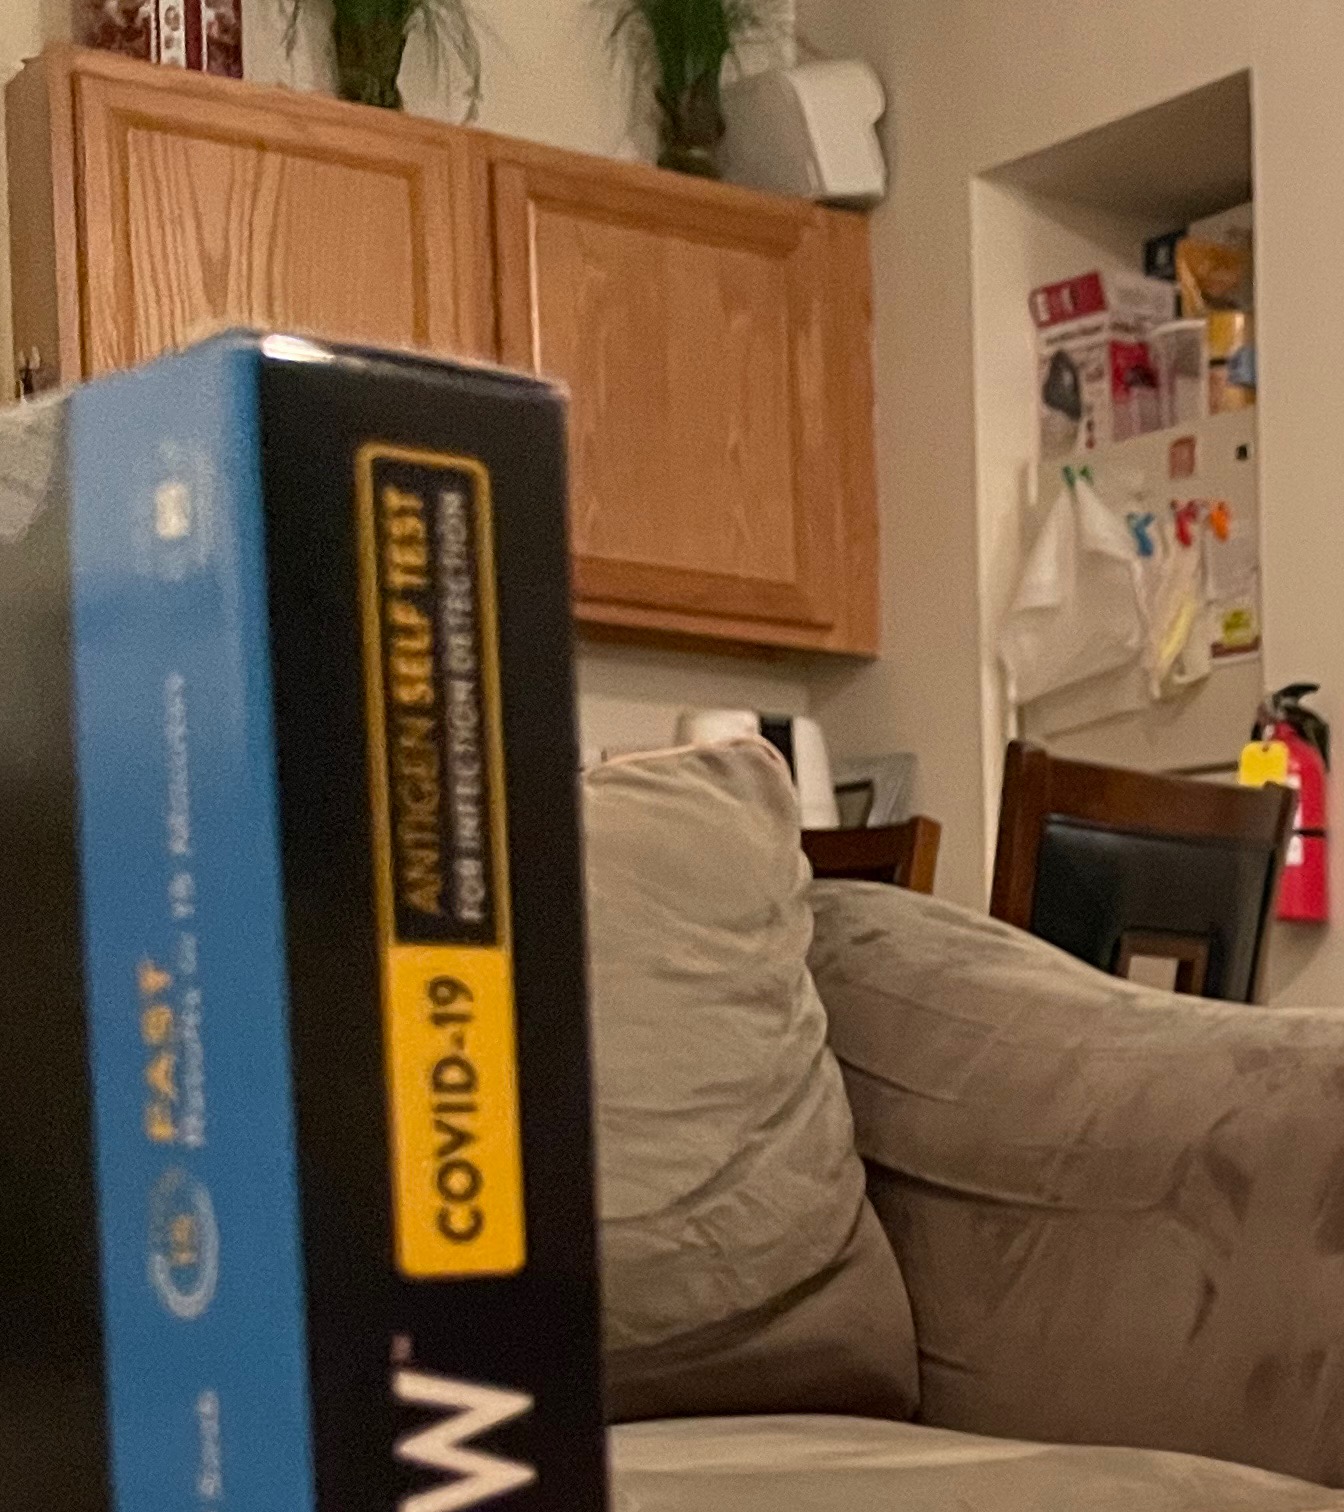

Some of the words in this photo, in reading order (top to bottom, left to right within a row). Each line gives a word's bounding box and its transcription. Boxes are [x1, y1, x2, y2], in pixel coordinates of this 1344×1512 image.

[383, 485, 427, 587] TEST
[390, 602, 434, 703] SELF
[399, 714, 441, 914] ANTIGEN
[427, 975, 484, 1243] COVID-19
